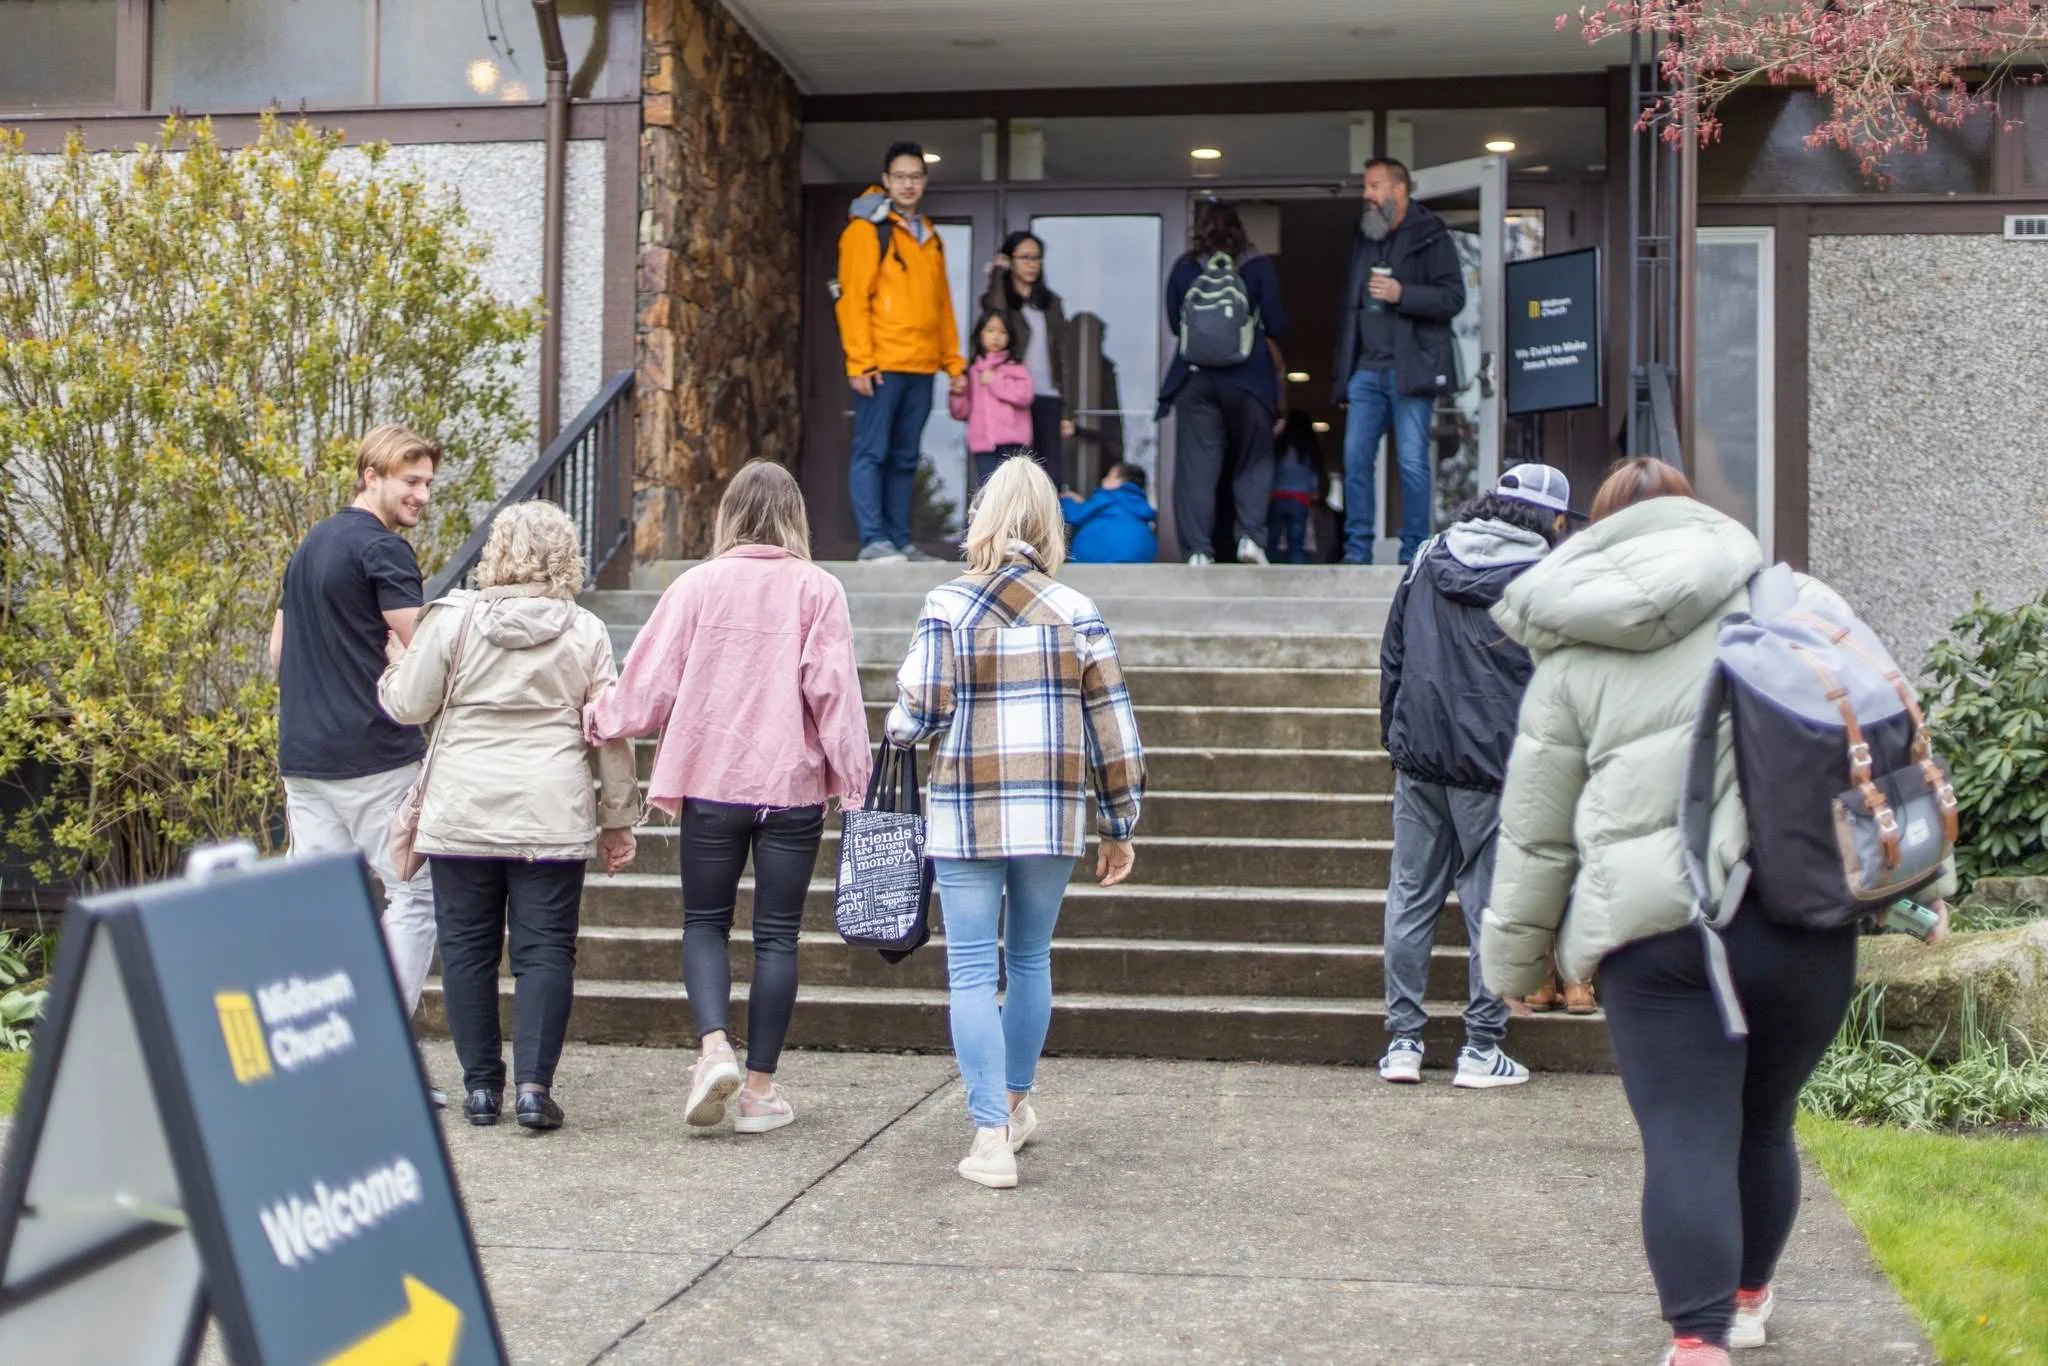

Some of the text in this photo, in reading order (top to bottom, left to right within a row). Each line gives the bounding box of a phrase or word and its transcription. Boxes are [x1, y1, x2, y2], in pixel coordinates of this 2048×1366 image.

[854, 827, 912, 848] friends
[855, 845, 873, 856] are
[875, 840, 904, 851] more
[888, 848, 904, 856] than
[857, 855, 902, 871] money
[883, 894, 920, 907] opposite
[851, 927, 867, 935] there
[859, 918, 885, 930] practice
[270, 1011, 355, 1072] Church
[259, 1157, 422, 1268] Welcome
